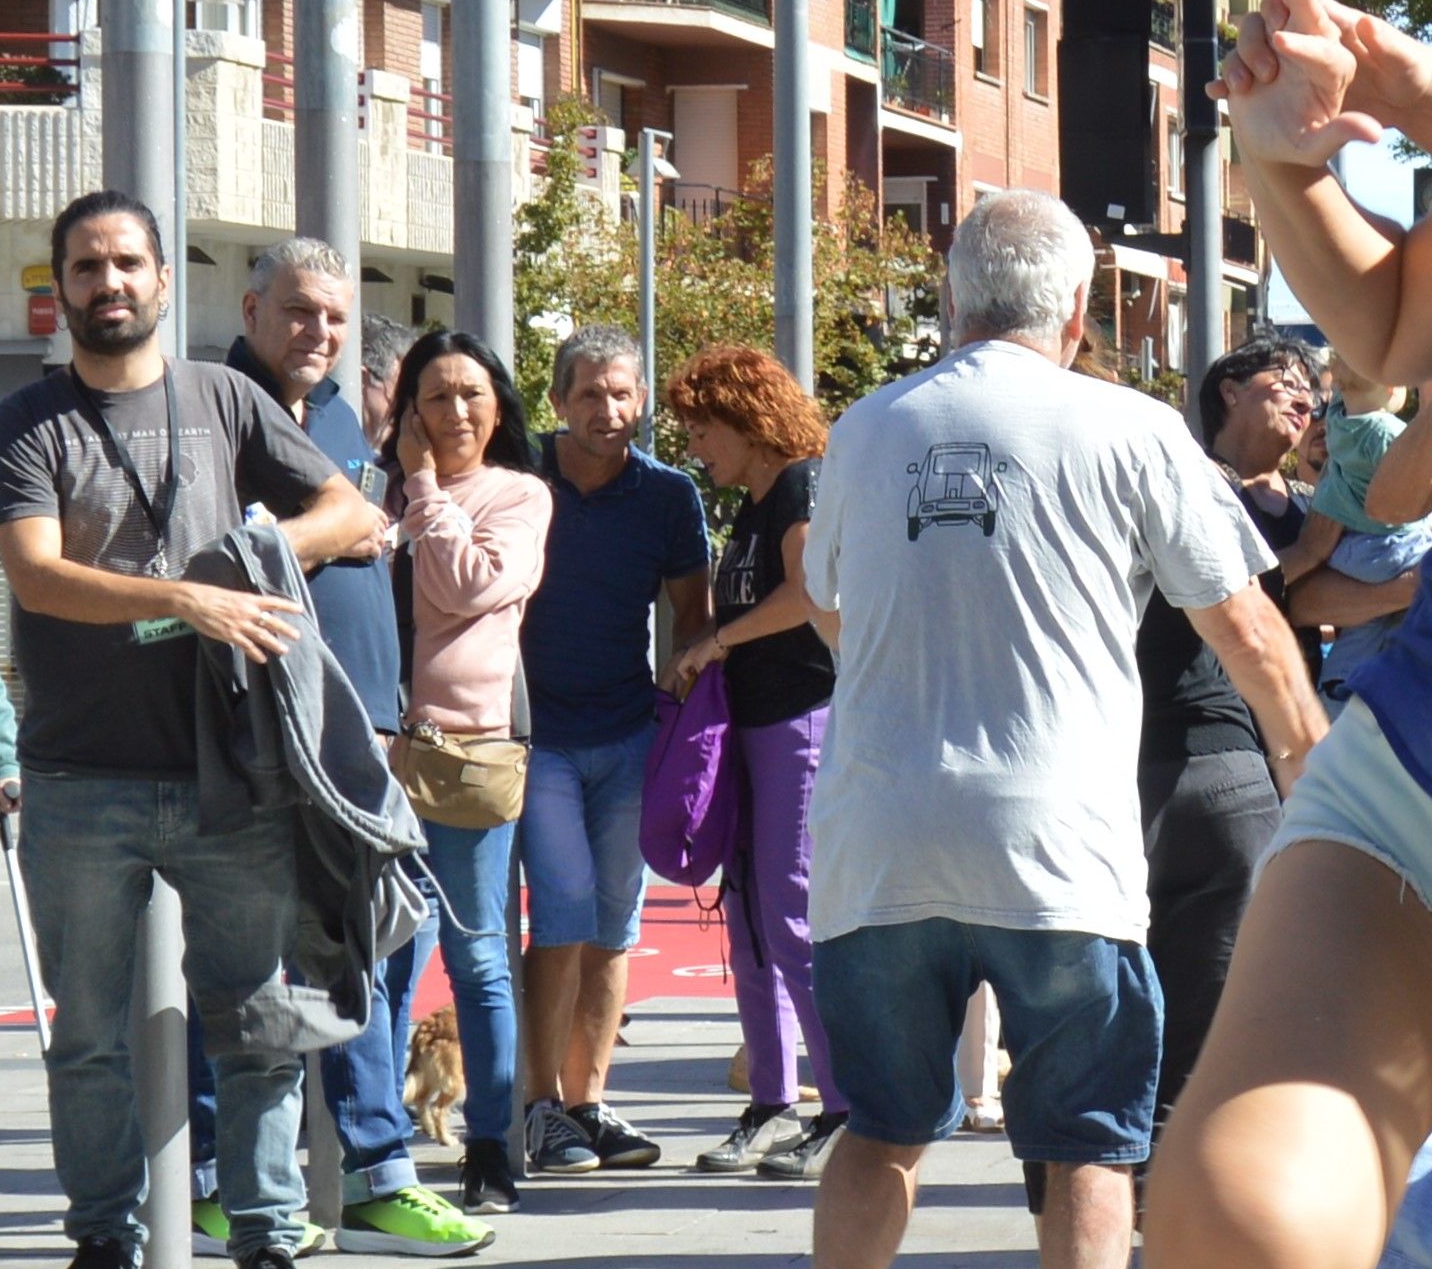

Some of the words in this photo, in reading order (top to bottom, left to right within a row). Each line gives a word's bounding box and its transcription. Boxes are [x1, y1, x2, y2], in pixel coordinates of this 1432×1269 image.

[132, 429, 157, 438] MAN
[179, 427, 212, 437] EARTH
[143, 621, 188, 639] STAFF
